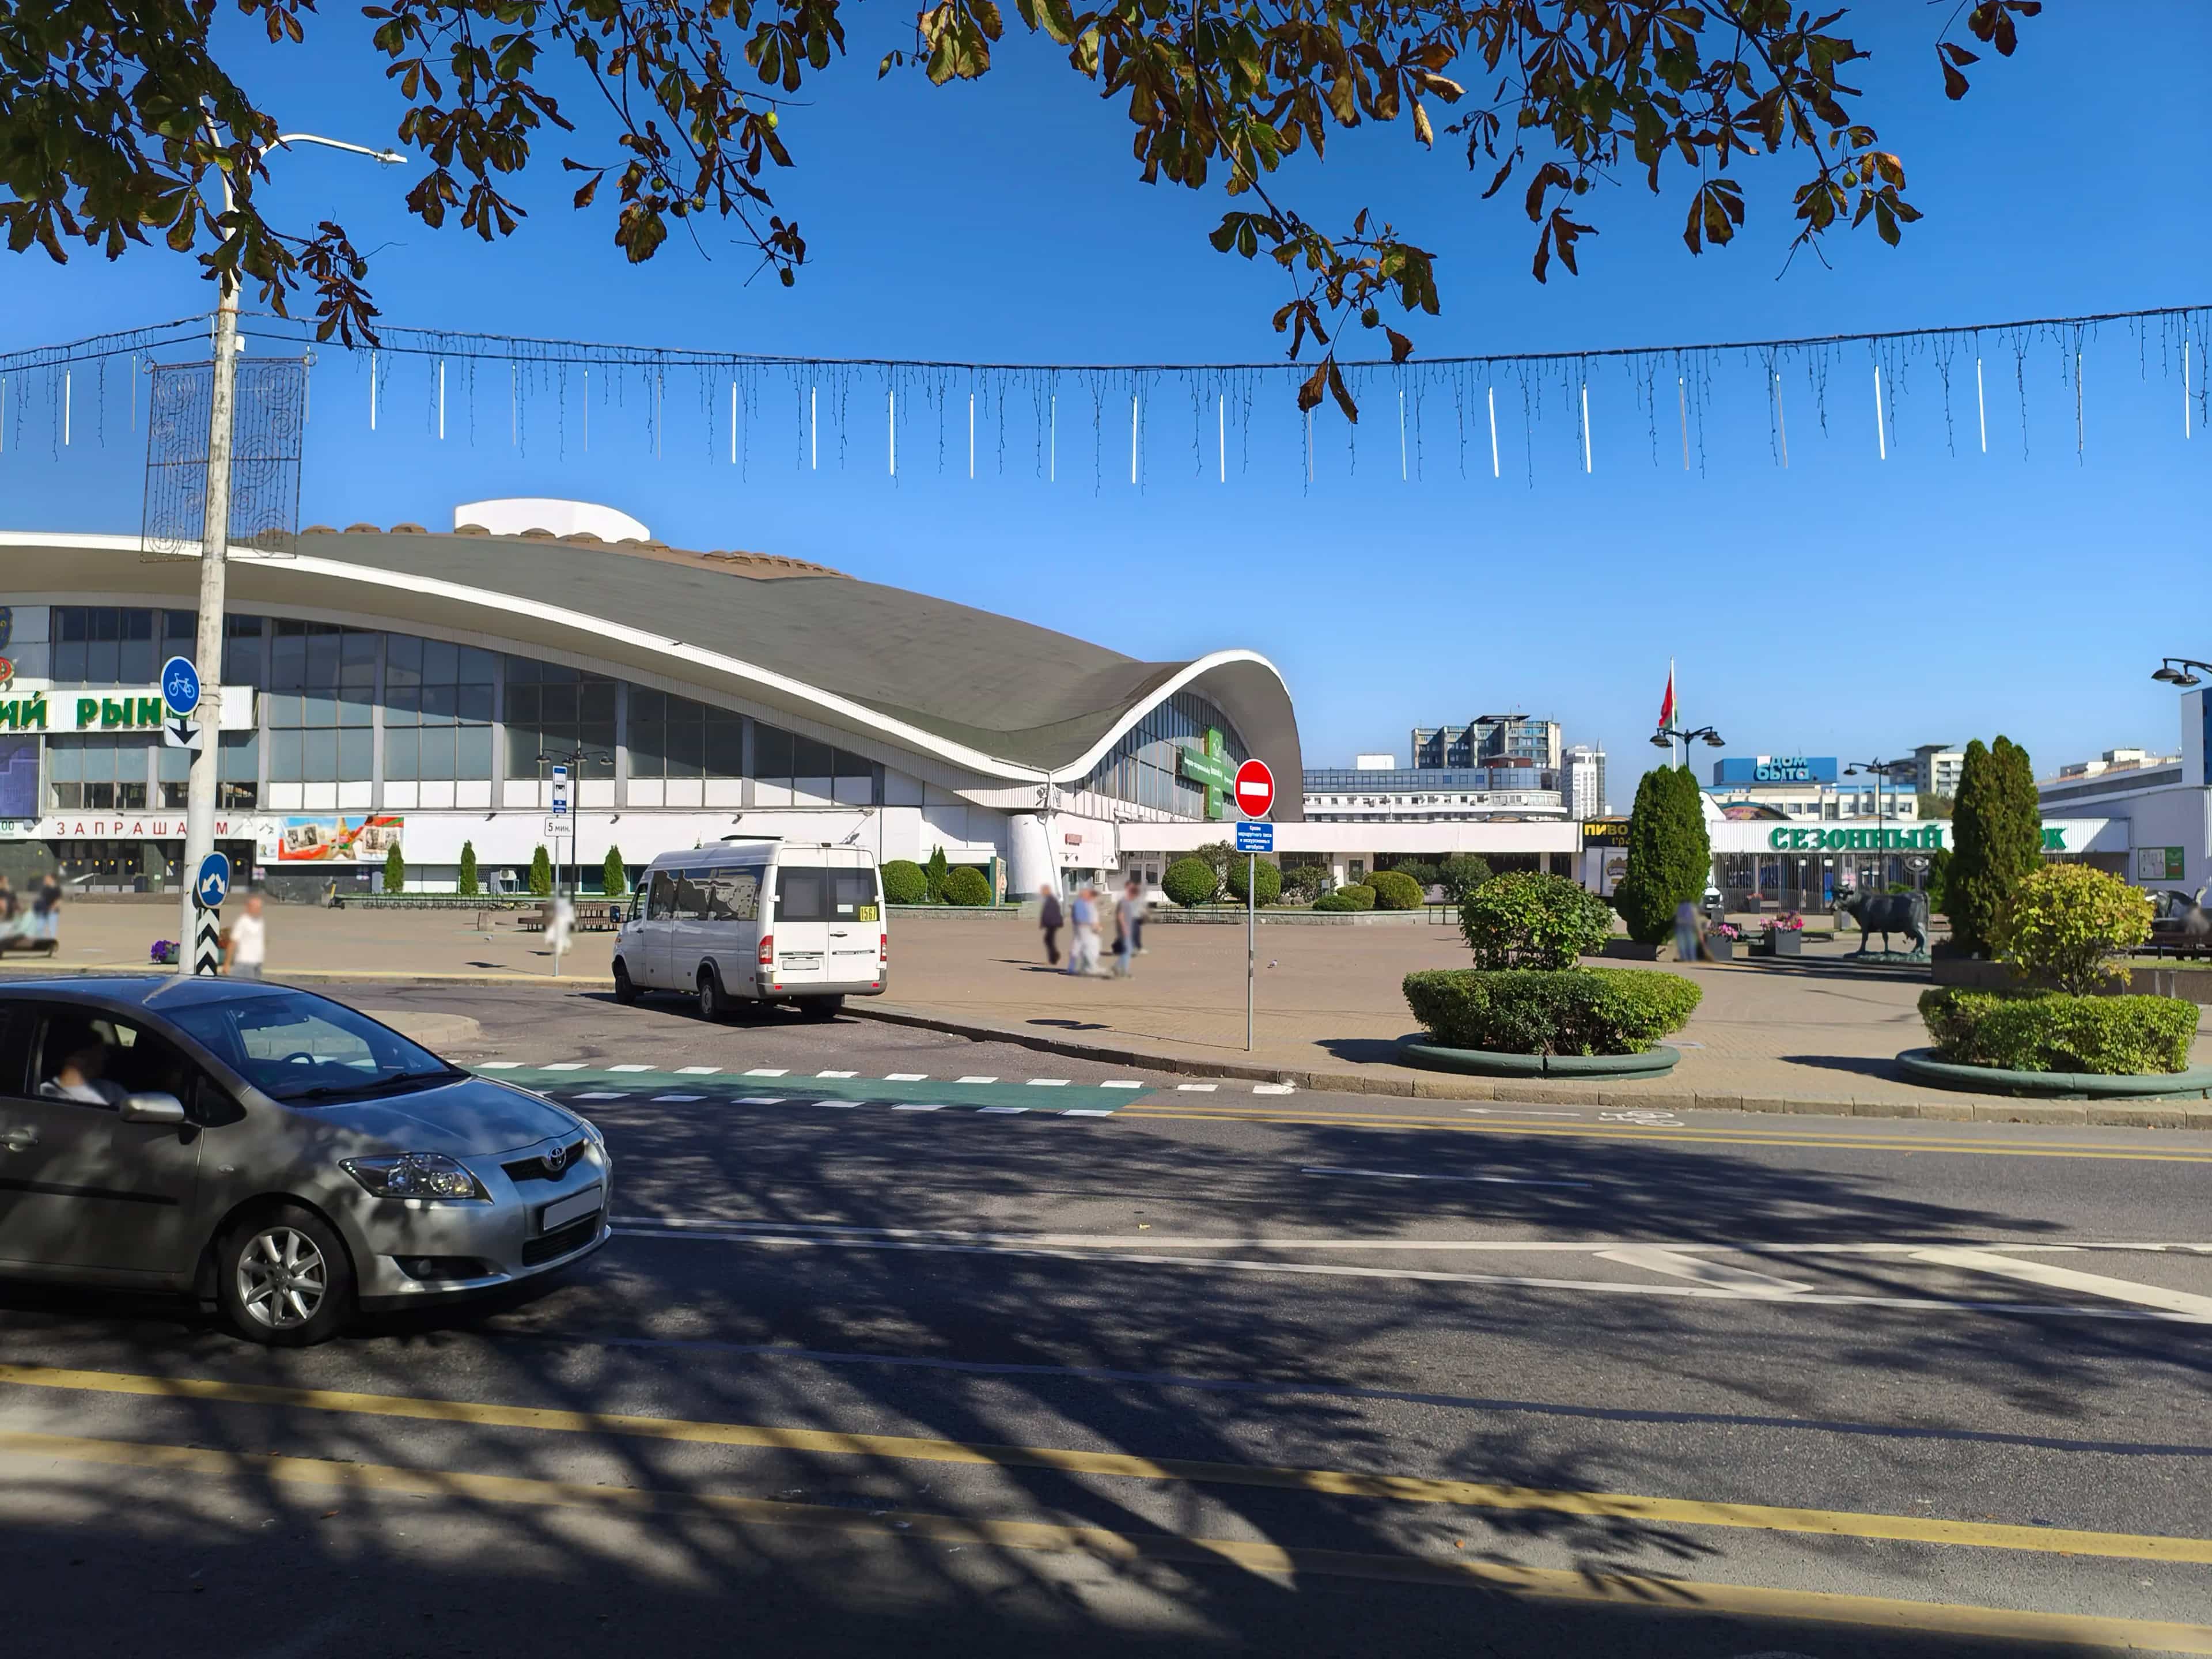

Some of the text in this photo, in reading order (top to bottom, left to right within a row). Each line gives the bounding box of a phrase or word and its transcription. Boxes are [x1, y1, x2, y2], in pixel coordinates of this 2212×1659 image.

[76, 698, 189, 728] РЫН
[56, 821, 228, 835] ЗАПРАШАМ
[548, 822, 553, 831] 5
[1770, 824, 1944, 850] СЕЗОННЫЙ
